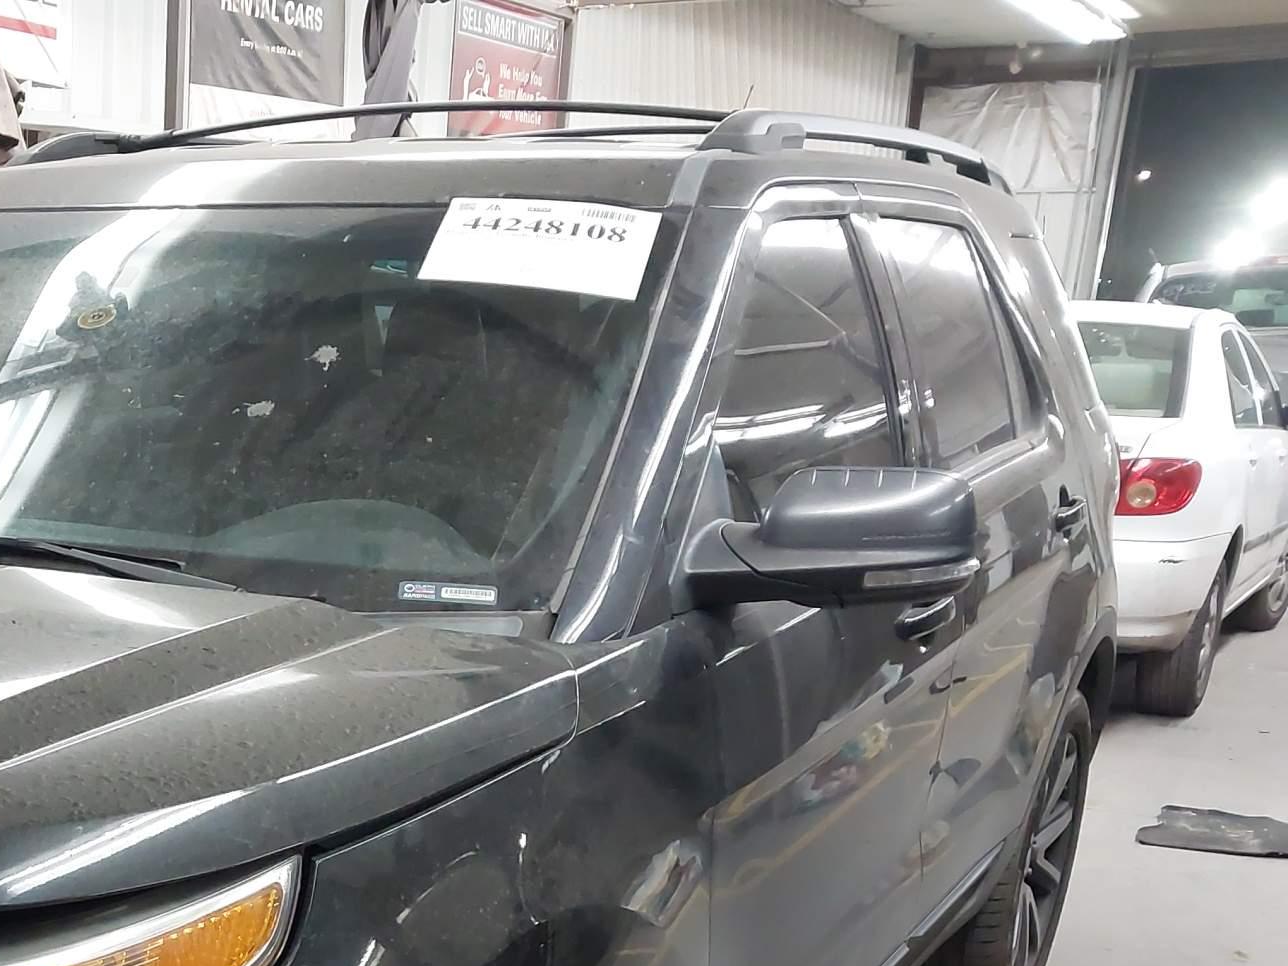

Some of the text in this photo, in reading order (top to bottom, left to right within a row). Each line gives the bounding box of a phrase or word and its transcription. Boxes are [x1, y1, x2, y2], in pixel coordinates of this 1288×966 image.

[284, 1, 324, 32] CARS
[463, 6, 483, 32] SELL
[485, 12, 516, 41] SMART
[518, 21, 540, 48] WITH
[499, 63, 511, 80] We
[530, 70, 543, 87] You
[463, 216, 628, 243] 44248108
